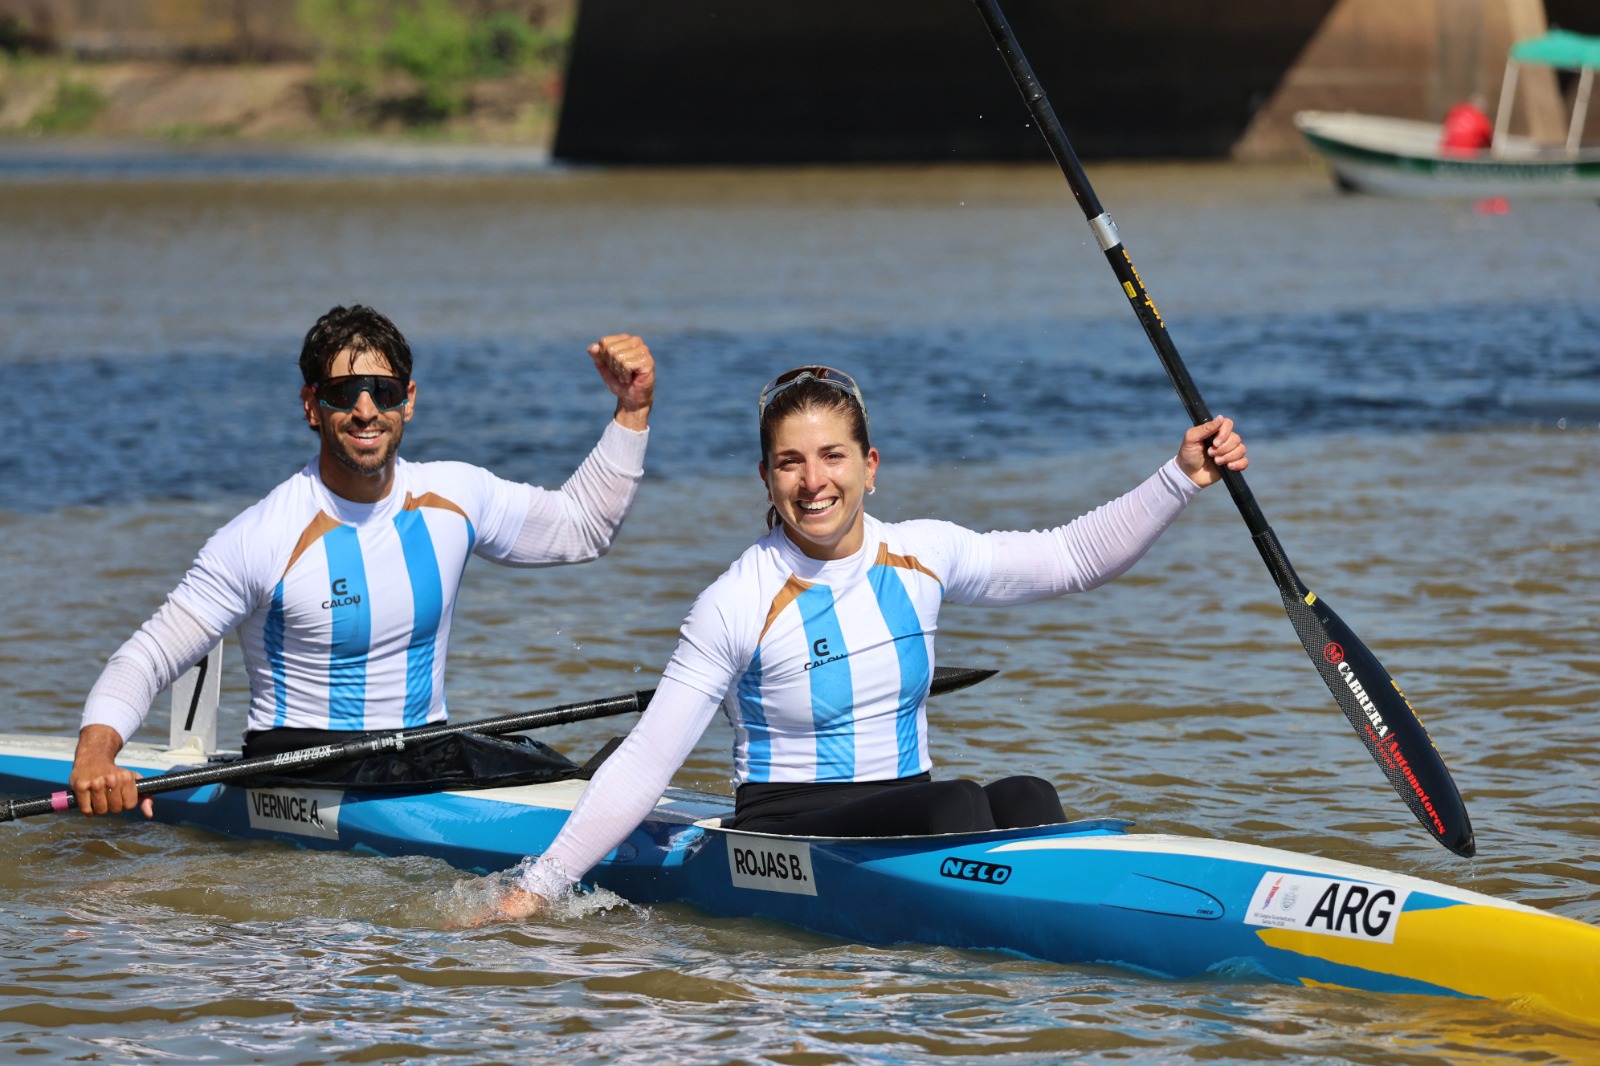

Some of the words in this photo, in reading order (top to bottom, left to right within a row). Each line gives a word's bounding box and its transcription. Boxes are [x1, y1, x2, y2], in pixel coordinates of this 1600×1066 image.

[321, 594, 361, 610] CALOU
[1338, 661, 1389, 738] CABRERA
[1387, 742, 1446, 835] Automotores
[251, 791, 308, 823] VERNICE
[310, 800, 324, 825] A.
[733, 847, 788, 879] ROJAS
[788, 854, 807, 881] B.
[942, 859, 1009, 882] NELO
[1305, 882, 1396, 937] ARG
